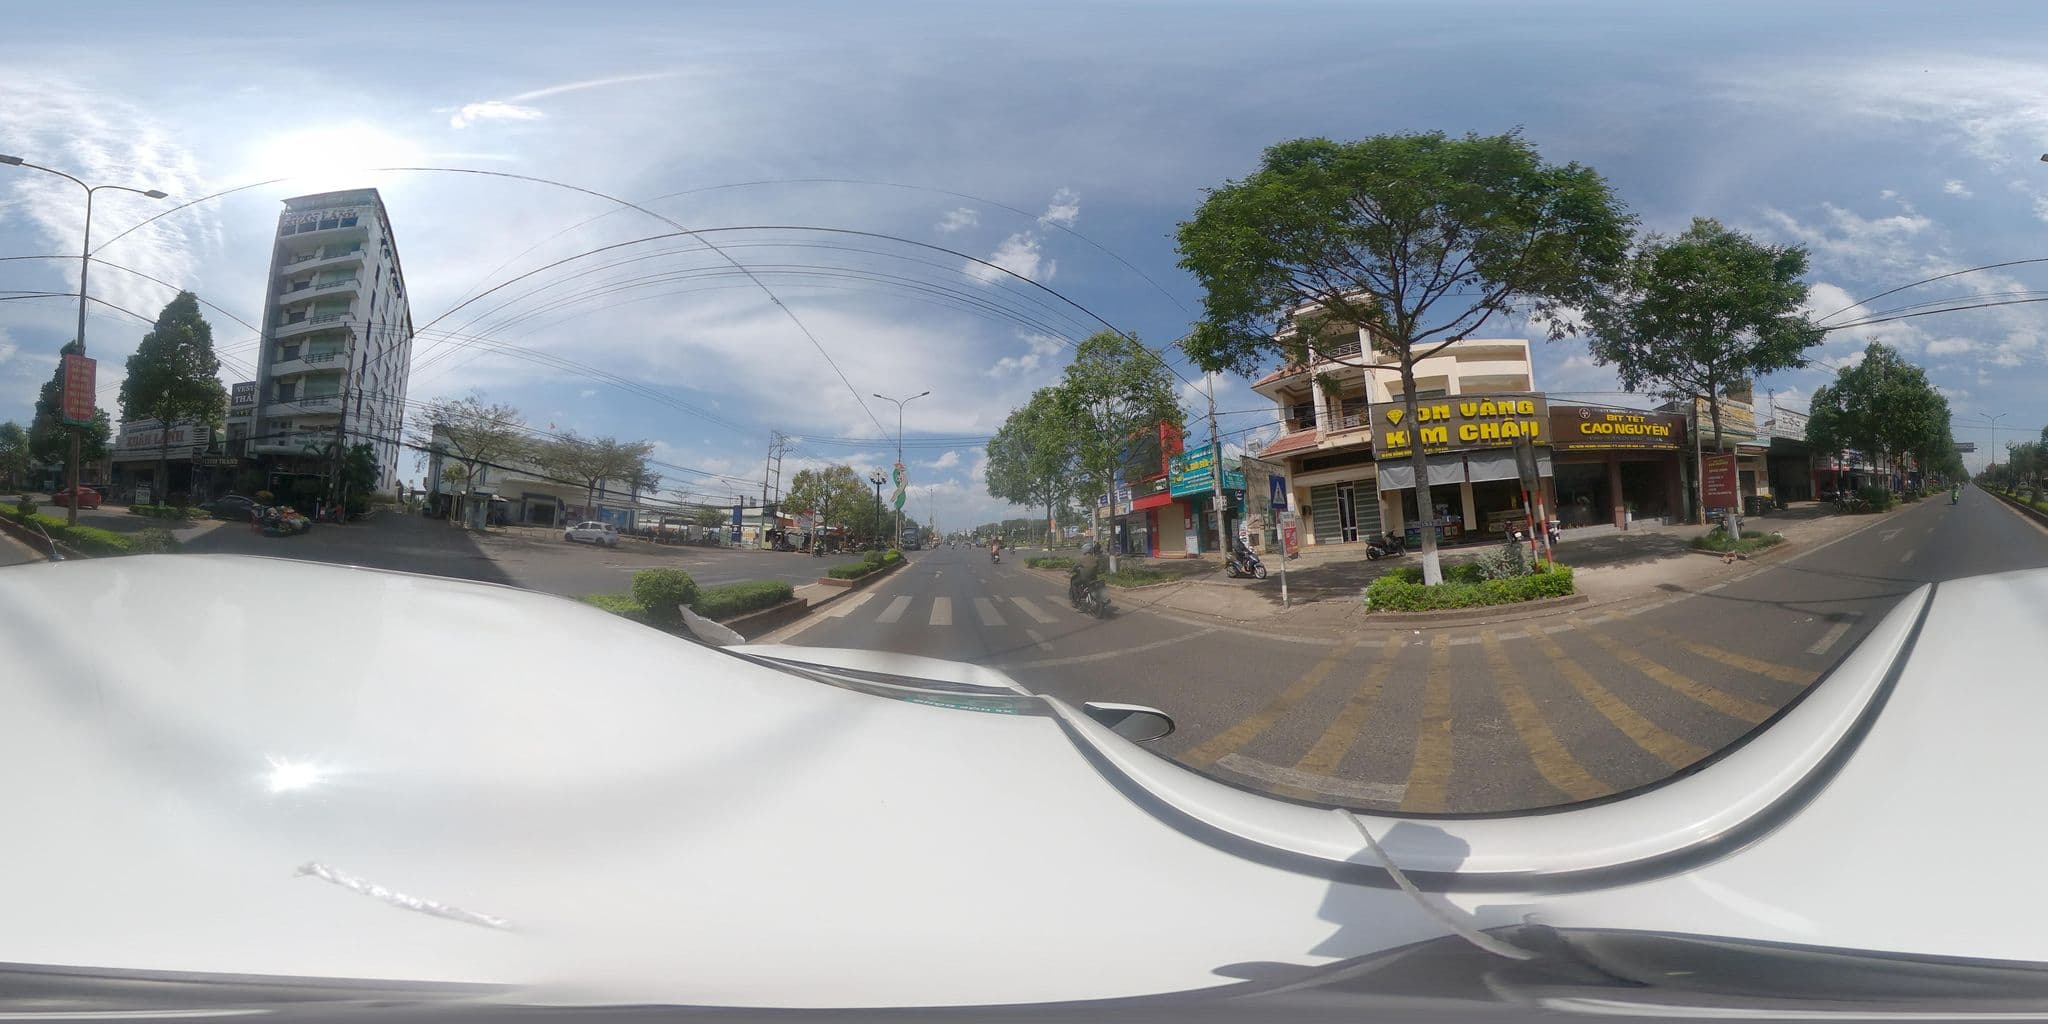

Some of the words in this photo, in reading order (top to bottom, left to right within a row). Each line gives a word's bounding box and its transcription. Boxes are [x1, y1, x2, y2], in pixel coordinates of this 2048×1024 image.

[1460, 398, 1534, 417] VÀNG
[1580, 423, 1613, 434] CAO
[1615, 422, 1669, 436] NGUYÊN
